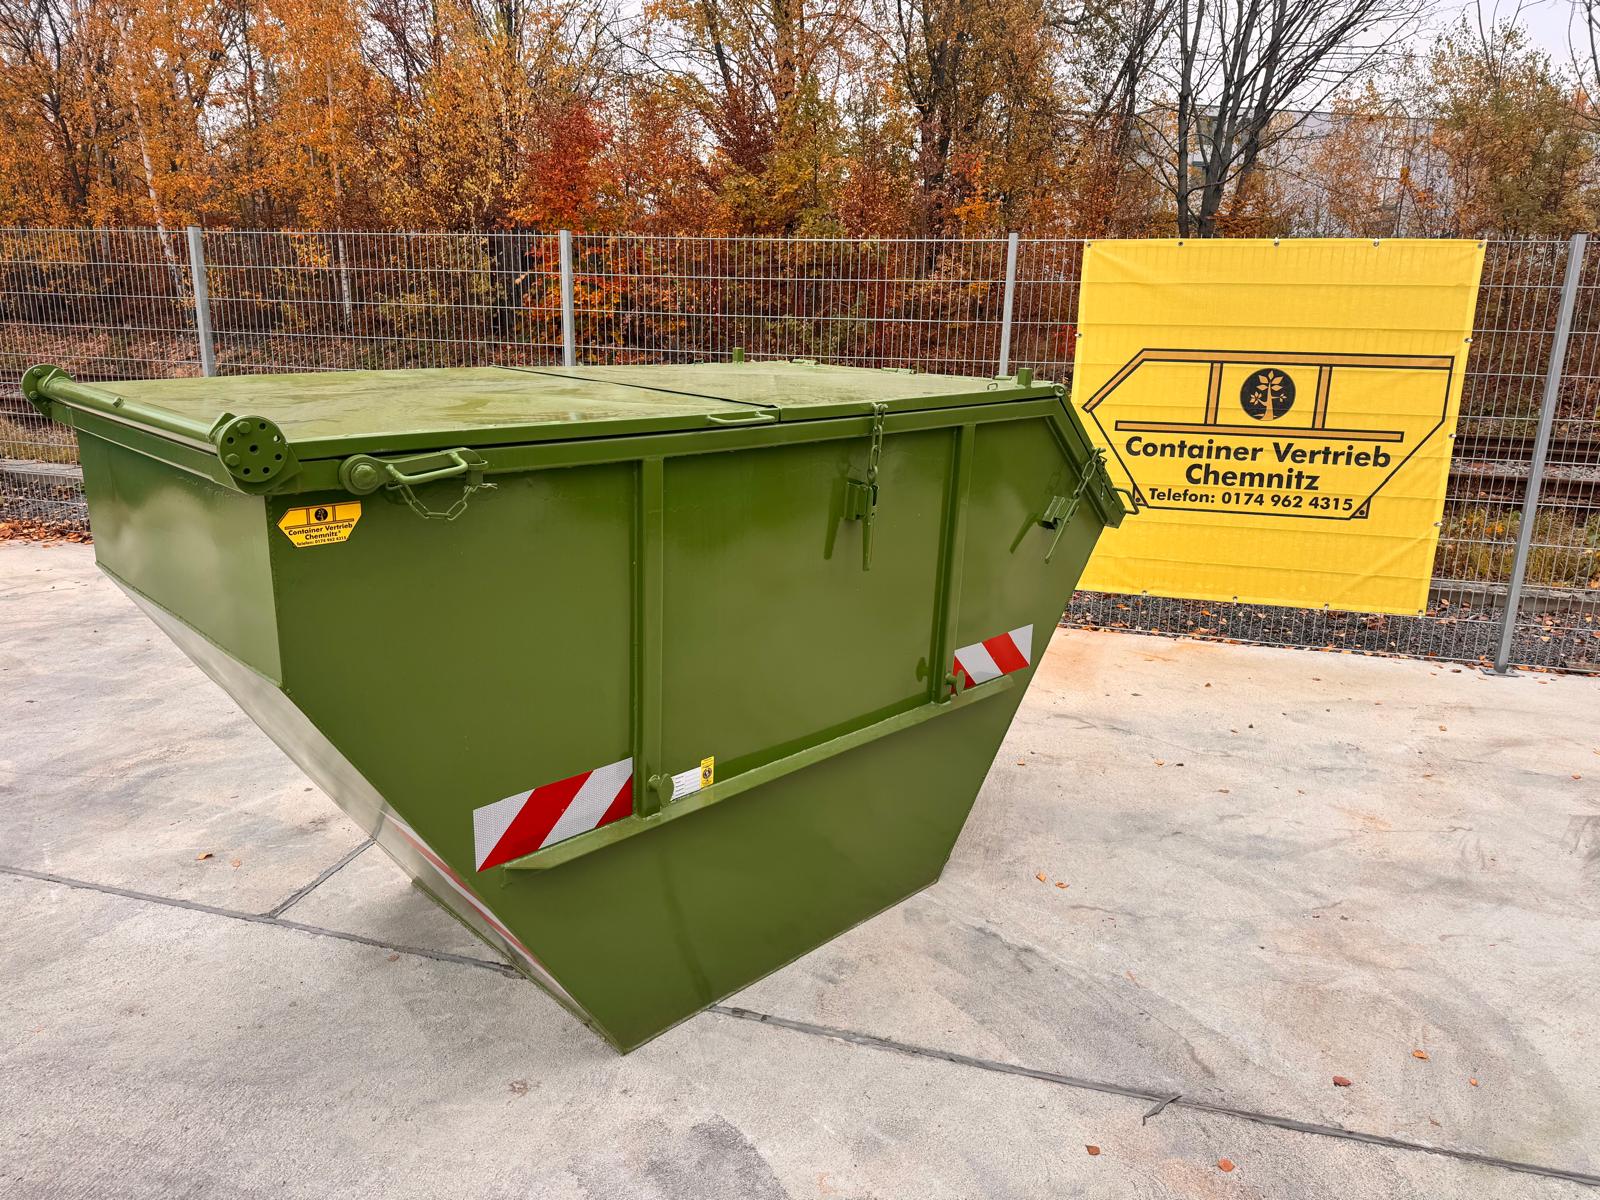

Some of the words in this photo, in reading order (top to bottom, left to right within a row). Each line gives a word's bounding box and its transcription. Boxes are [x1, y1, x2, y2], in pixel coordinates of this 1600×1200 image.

[1125, 435, 1263, 461] Container
[1273, 442, 1391, 468] Vertrieb
[1185, 463, 1320, 491] Chemnitz
[1149, 487, 1215, 504] Telefon:
[1221, 491, 1264, 507] 0174
[1270, 493, 1303, 509] 962
[1308, 496, 1353, 511] 4315
[288, 527, 323, 536] Container
[325, 523, 353, 531] Vertrieb
